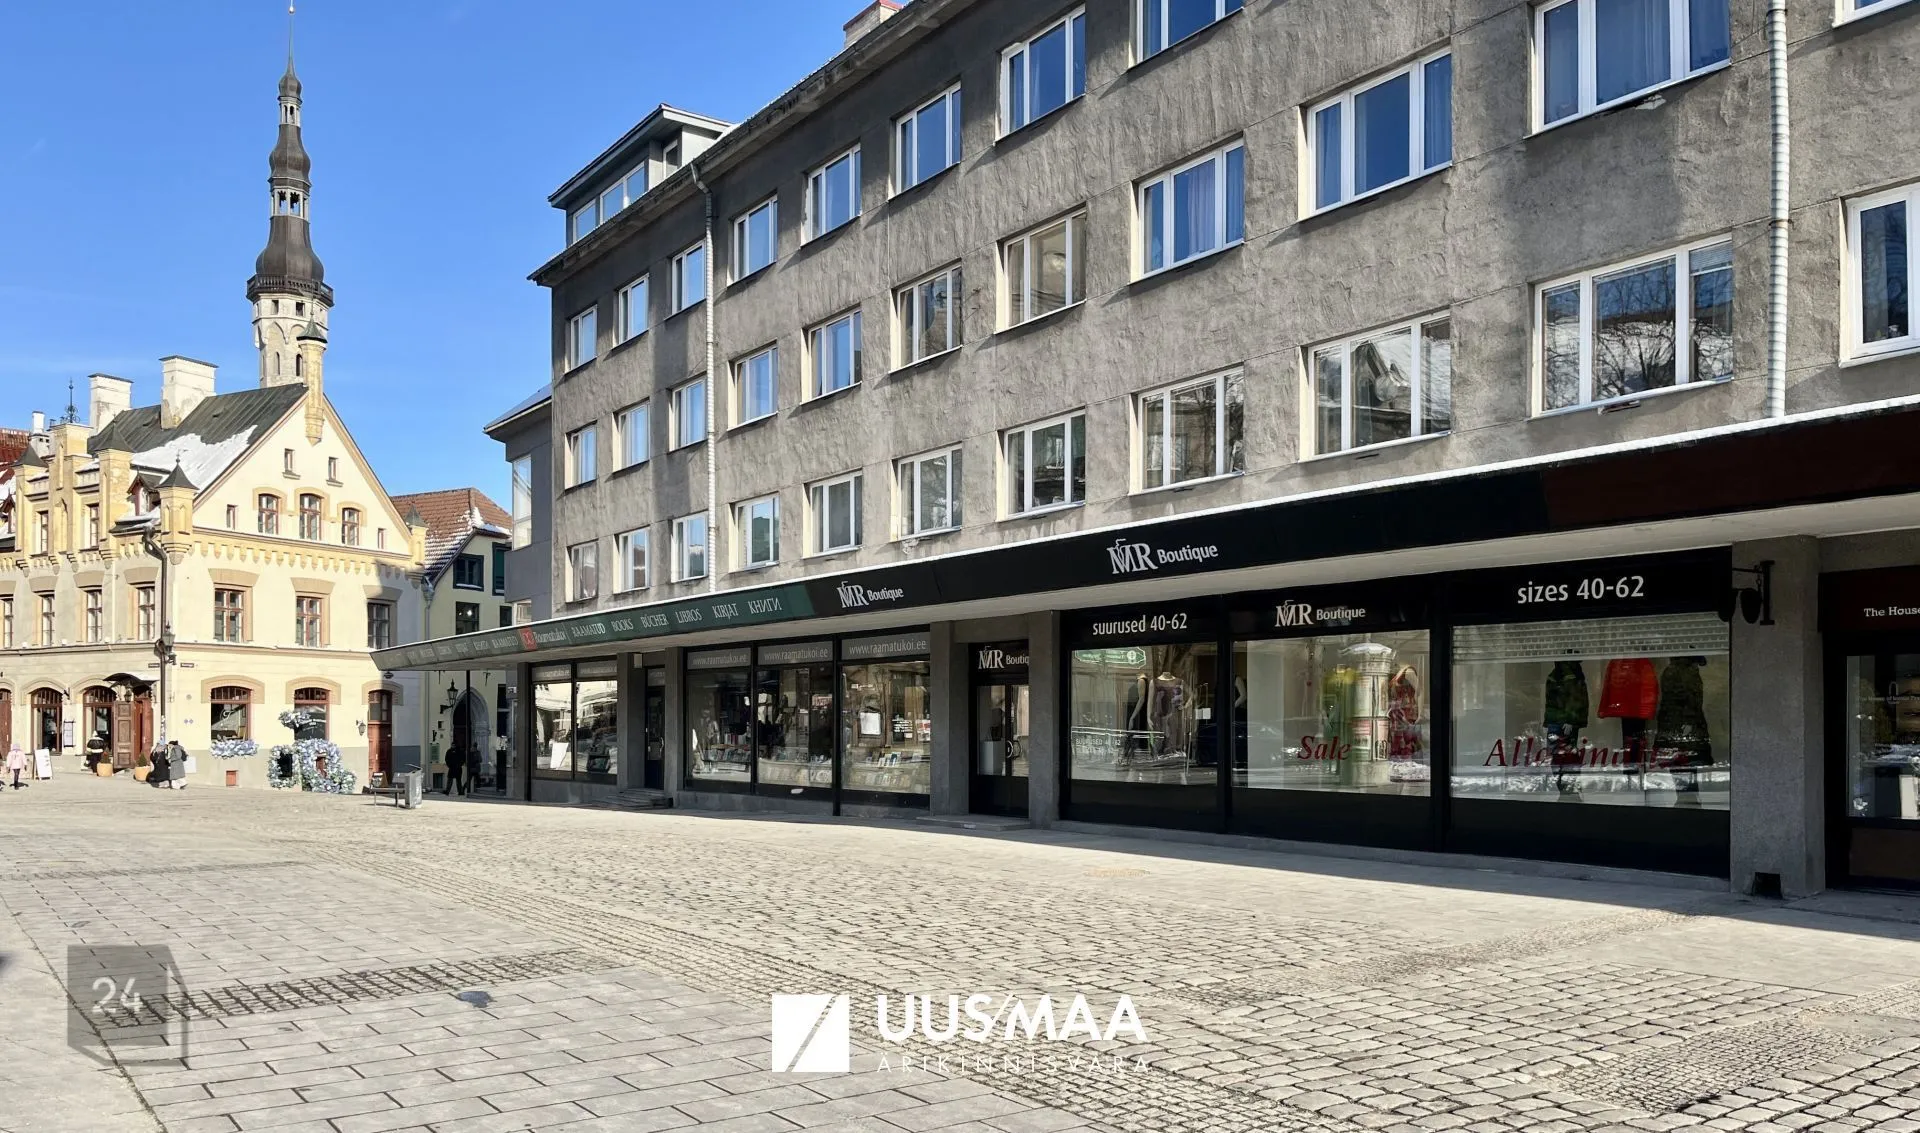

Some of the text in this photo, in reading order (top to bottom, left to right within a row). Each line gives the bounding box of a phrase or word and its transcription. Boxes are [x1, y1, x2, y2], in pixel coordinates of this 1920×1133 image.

[1106, 538, 1219, 574] MR Boutique
[836, 580, 904, 608] MR Boutique
[1517, 575, 1644, 604] sizes 40-62
[571, 622, 606, 638] RAAMATUD
[611, 618, 634, 632] BOOKS
[675, 607, 703, 624] LIBROS
[711, 603, 739, 620] KIRJAT
[1092, 612, 1187, 635] suurused 40-62
[1274, 599, 1366, 627] MR Boutique
[1863, 607, 1886, 617] The
[764, 647, 829, 662] www.raamatukoi.ee
[849, 638, 927, 656] www.raamatukoi.ee
[978, 645, 1030, 669] MR Boutiq
[1297, 735, 1352, 761] Sale
